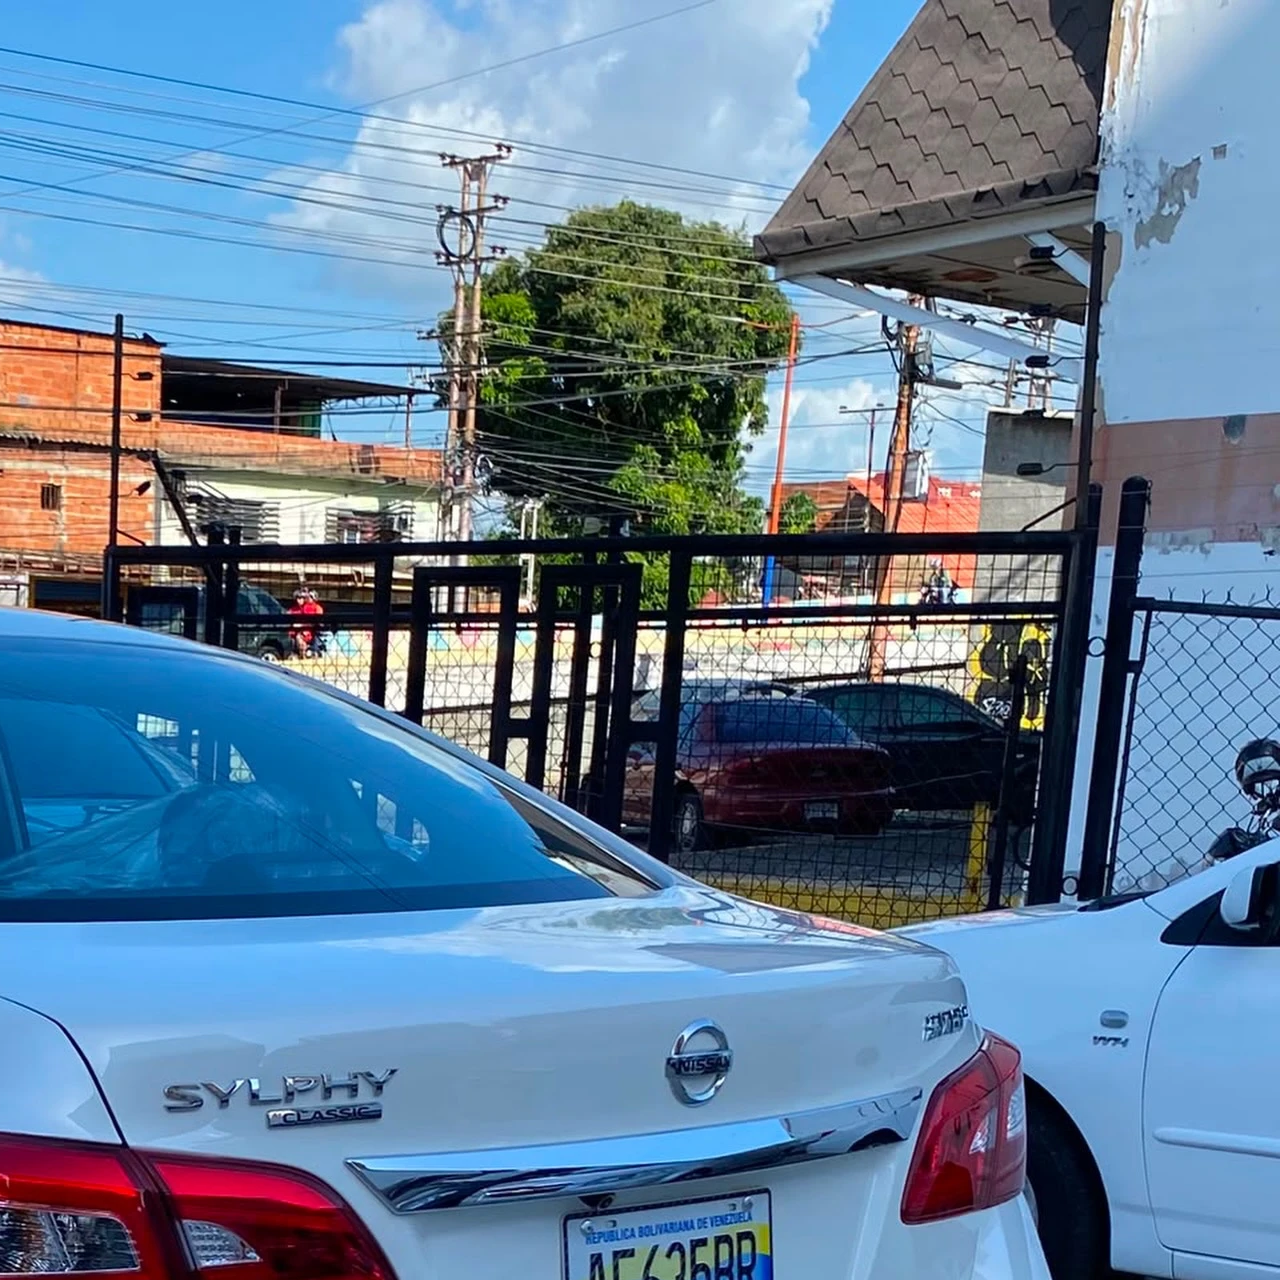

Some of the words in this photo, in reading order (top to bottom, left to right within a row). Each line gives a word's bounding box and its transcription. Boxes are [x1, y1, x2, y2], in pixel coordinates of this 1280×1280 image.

[163, 1068, 399, 1112] SYLPHY
[282, 1106, 370, 1124] CLASSIC
[638, 1219, 695, 1238] BOLIVARIANA
[697, 1216, 708, 1229] DE
[709, 1211, 753, 1228] VENEZUELA
